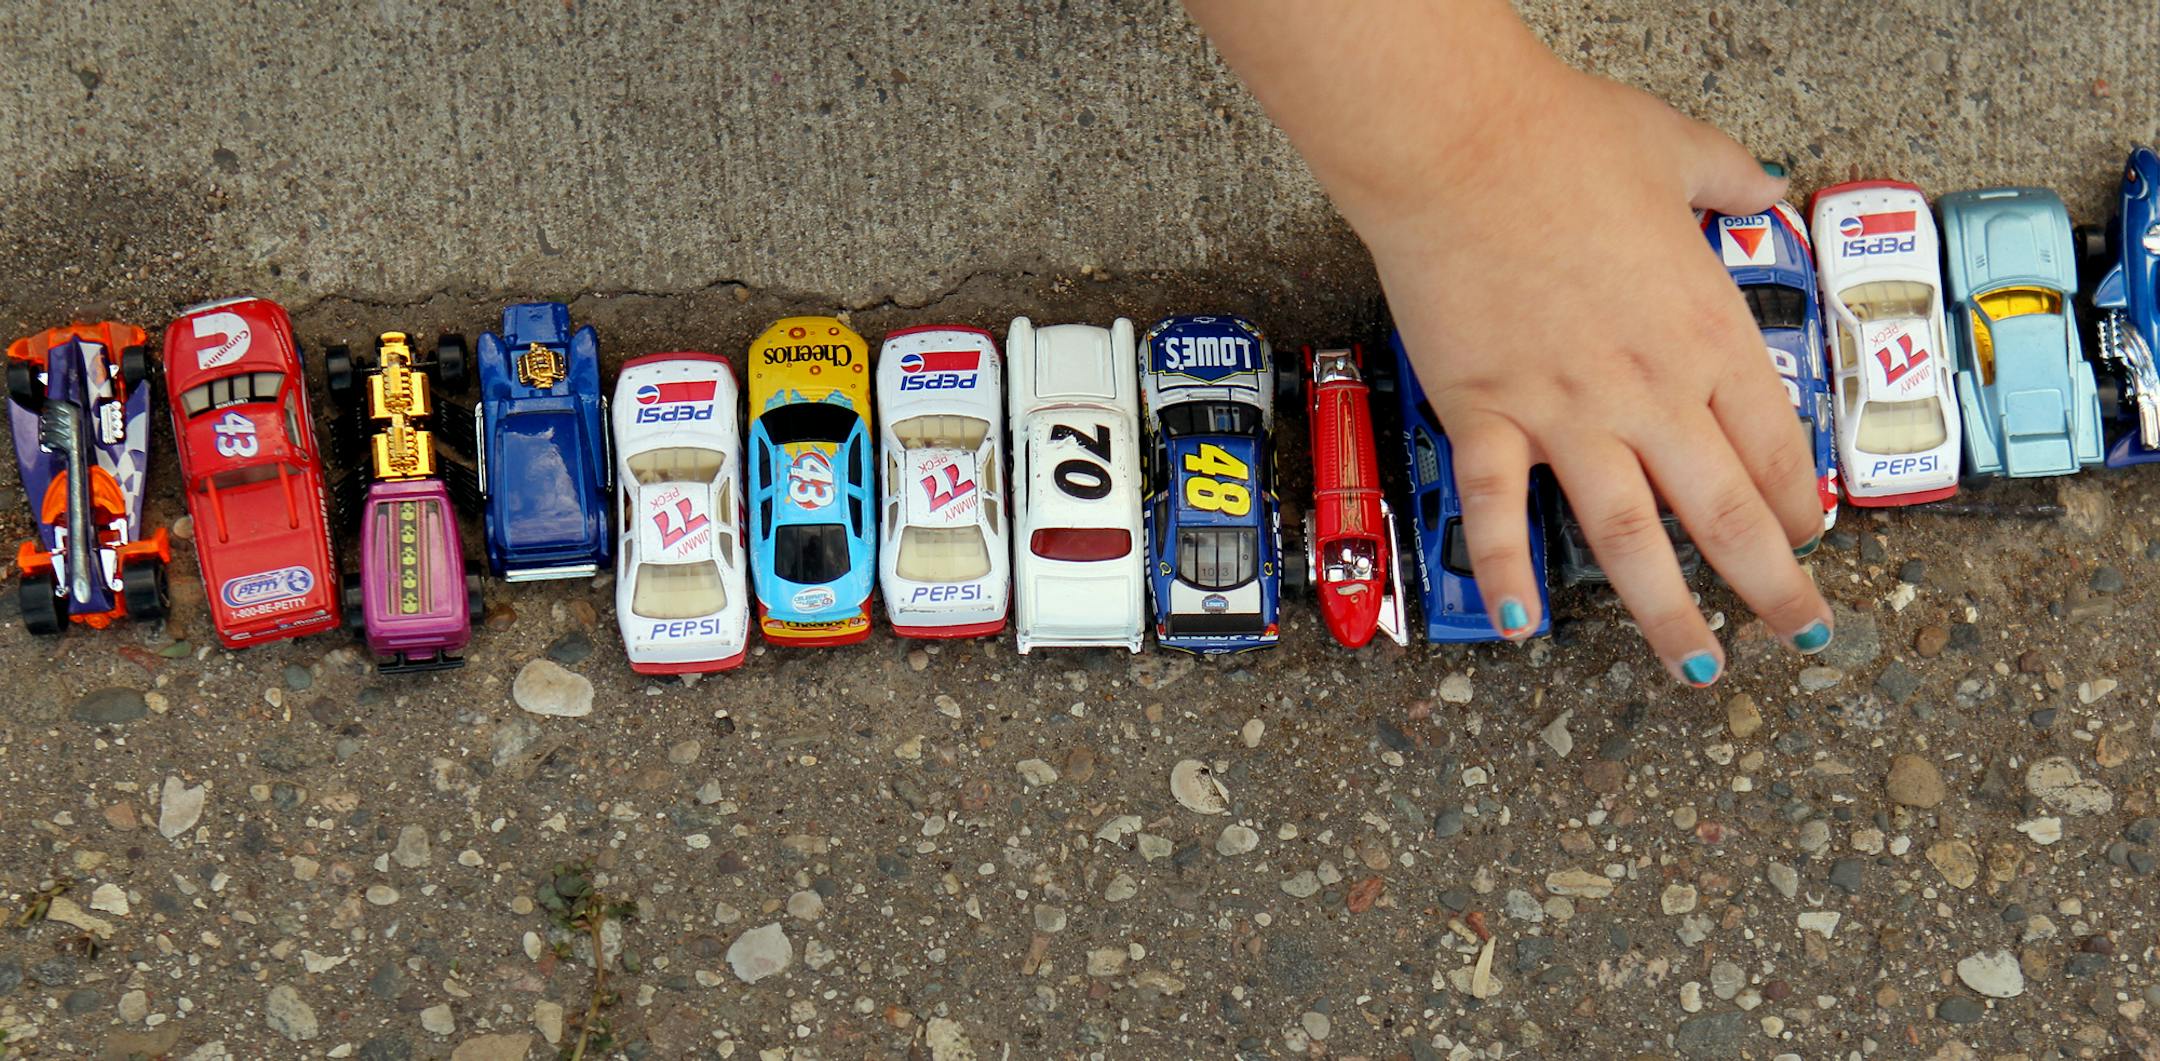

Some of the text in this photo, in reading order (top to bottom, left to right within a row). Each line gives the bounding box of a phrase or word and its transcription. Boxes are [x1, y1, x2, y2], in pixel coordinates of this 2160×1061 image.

[1724, 217, 1765, 227] CITGO
[1842, 235, 1915, 258] PEPSI
[1871, 321, 1900, 347] PECK
[203, 330, 249, 367] Cummins
[763, 344, 852, 367] Cheerios
[1165, 337, 1252, 370] LOWE'S
[1875, 332, 1930, 388] 77
[900, 373, 978, 391] PEPSI
[1901, 364, 1931, 396] JIMMY
[636, 404, 714, 424] PEPSI
[213, 411, 258, 459] 43
[1050, 424, 1112, 500] 70
[1871, 455, 1938, 478] PEPSI
[787, 456, 835, 508] 43
[920, 463, 976, 513] 77
[1184, 443, 1251, 517] 48
[650, 487, 681, 511] PECK
[944, 494, 977, 523] JIMMY
[652, 497, 710, 550] 77
[677, 528, 710, 560] JIMMY
[1412, 518, 1431, 593] MOPAR
[1201, 567, 1230, 577] 103
[236, 577, 281, 598] PETTY
[911, 584, 981, 603] PEPSI
[231, 597, 307, 619] 1-800-BE-PETTY
[650, 618, 720, 640] PEPSI
